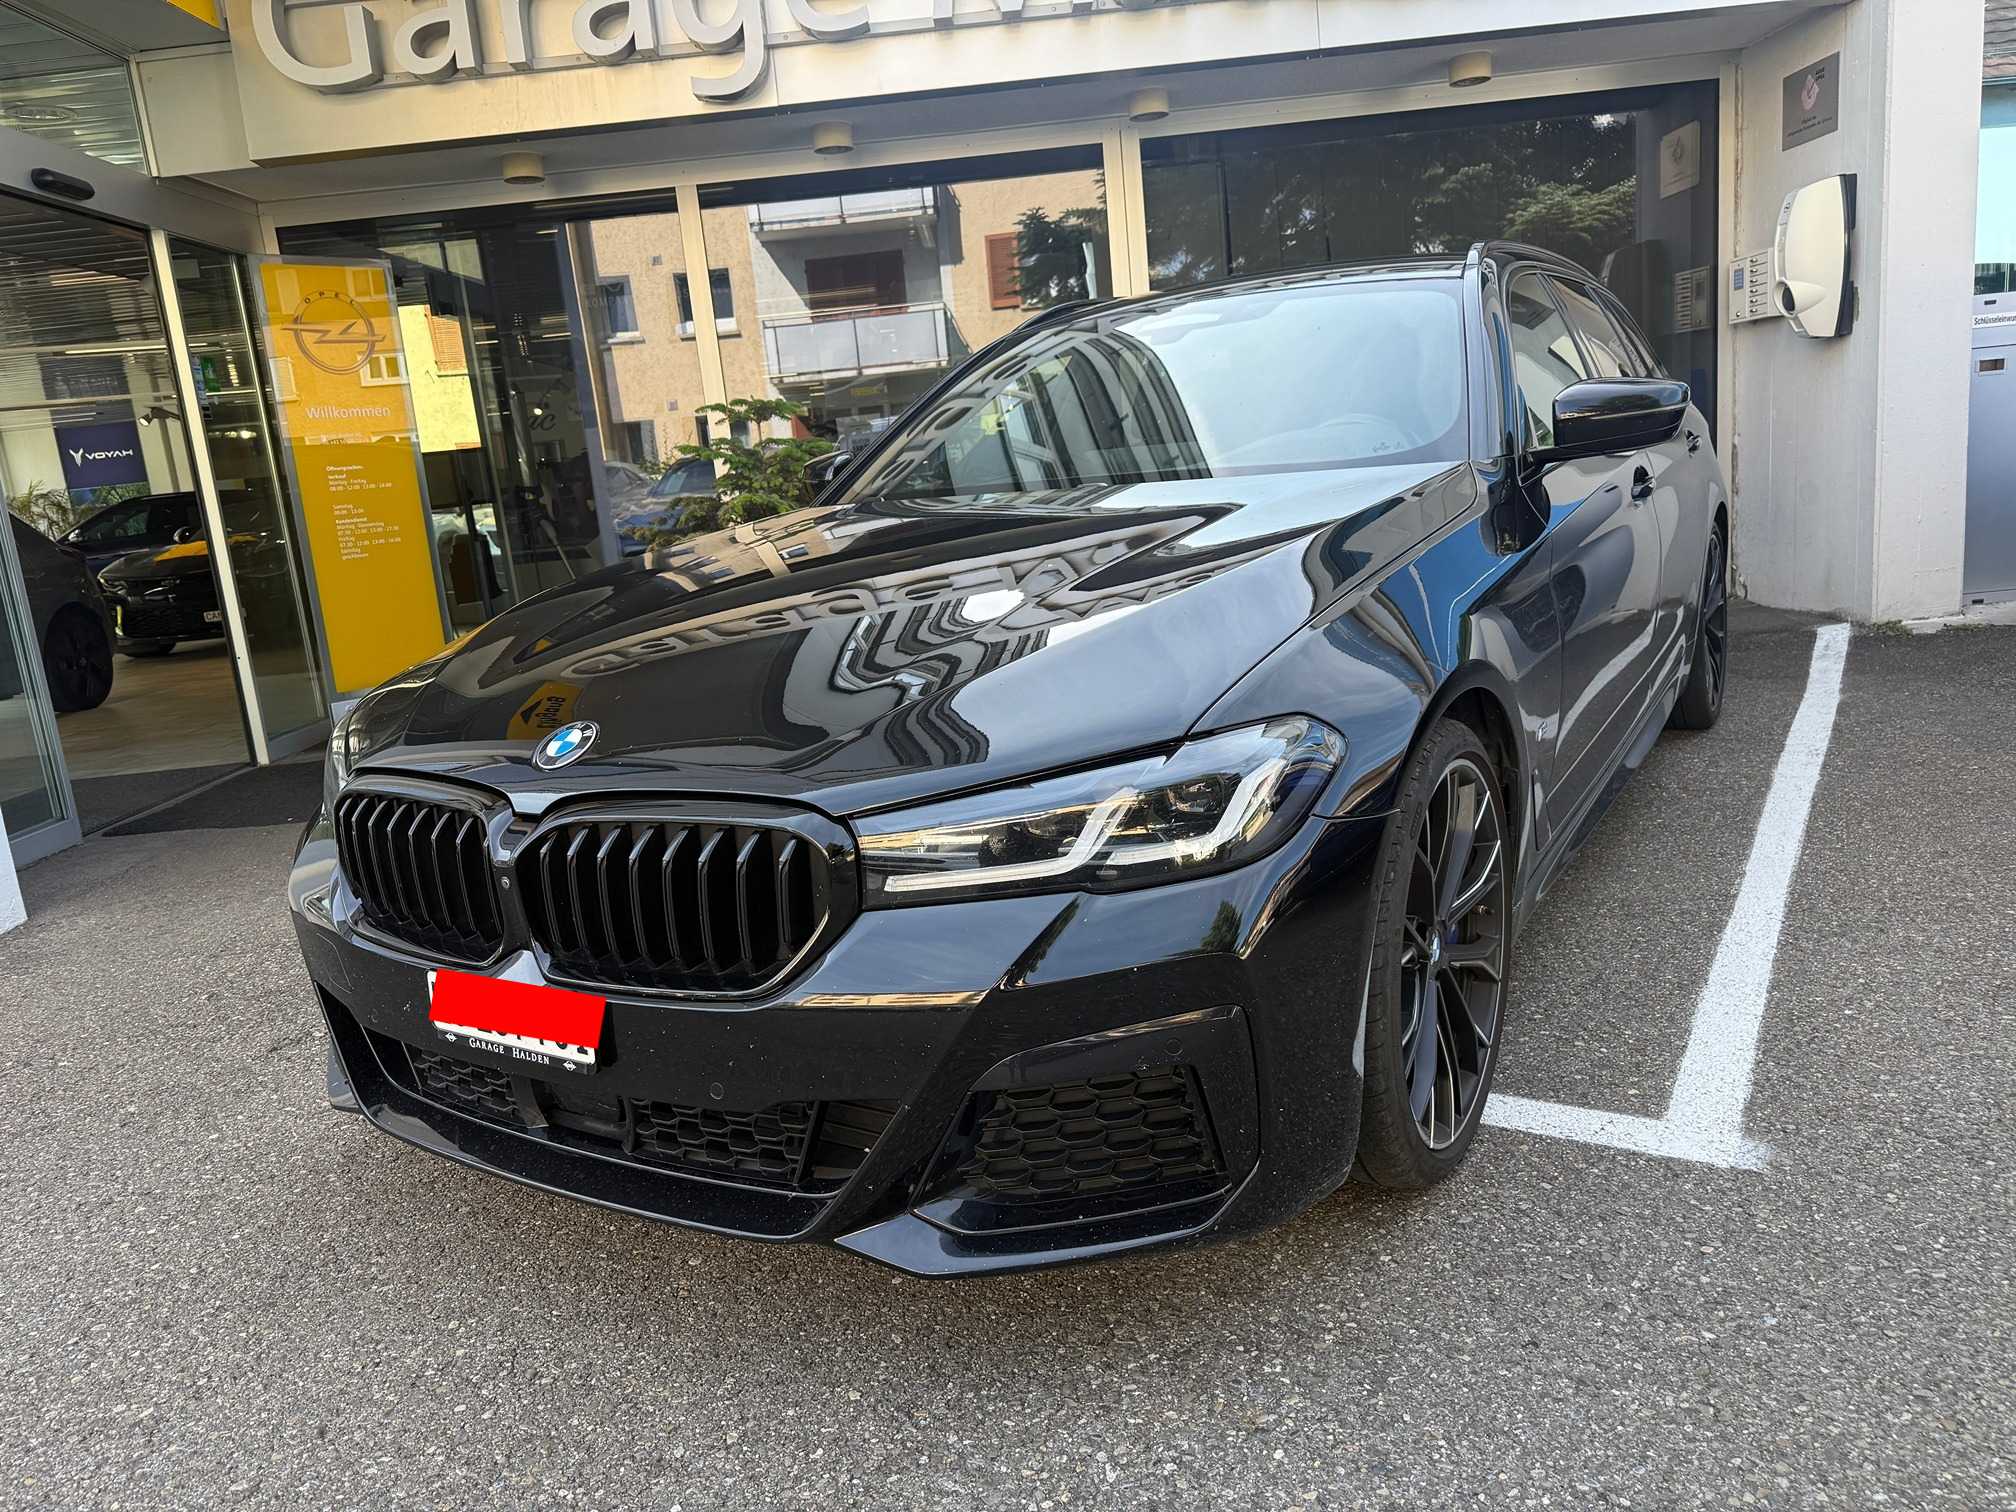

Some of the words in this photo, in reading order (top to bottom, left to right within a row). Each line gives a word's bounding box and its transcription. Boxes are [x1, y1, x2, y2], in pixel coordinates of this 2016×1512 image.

[252, 0, 869, 102] Gaag
[304, 291, 356, 306] OPEL
[305, 406, 391, 419] Willkommen
[85, 449, 134, 461] VOYAH
[468, 1037, 505, 1054] GARAGE
[512, 1048, 550, 1065] HALDEN
